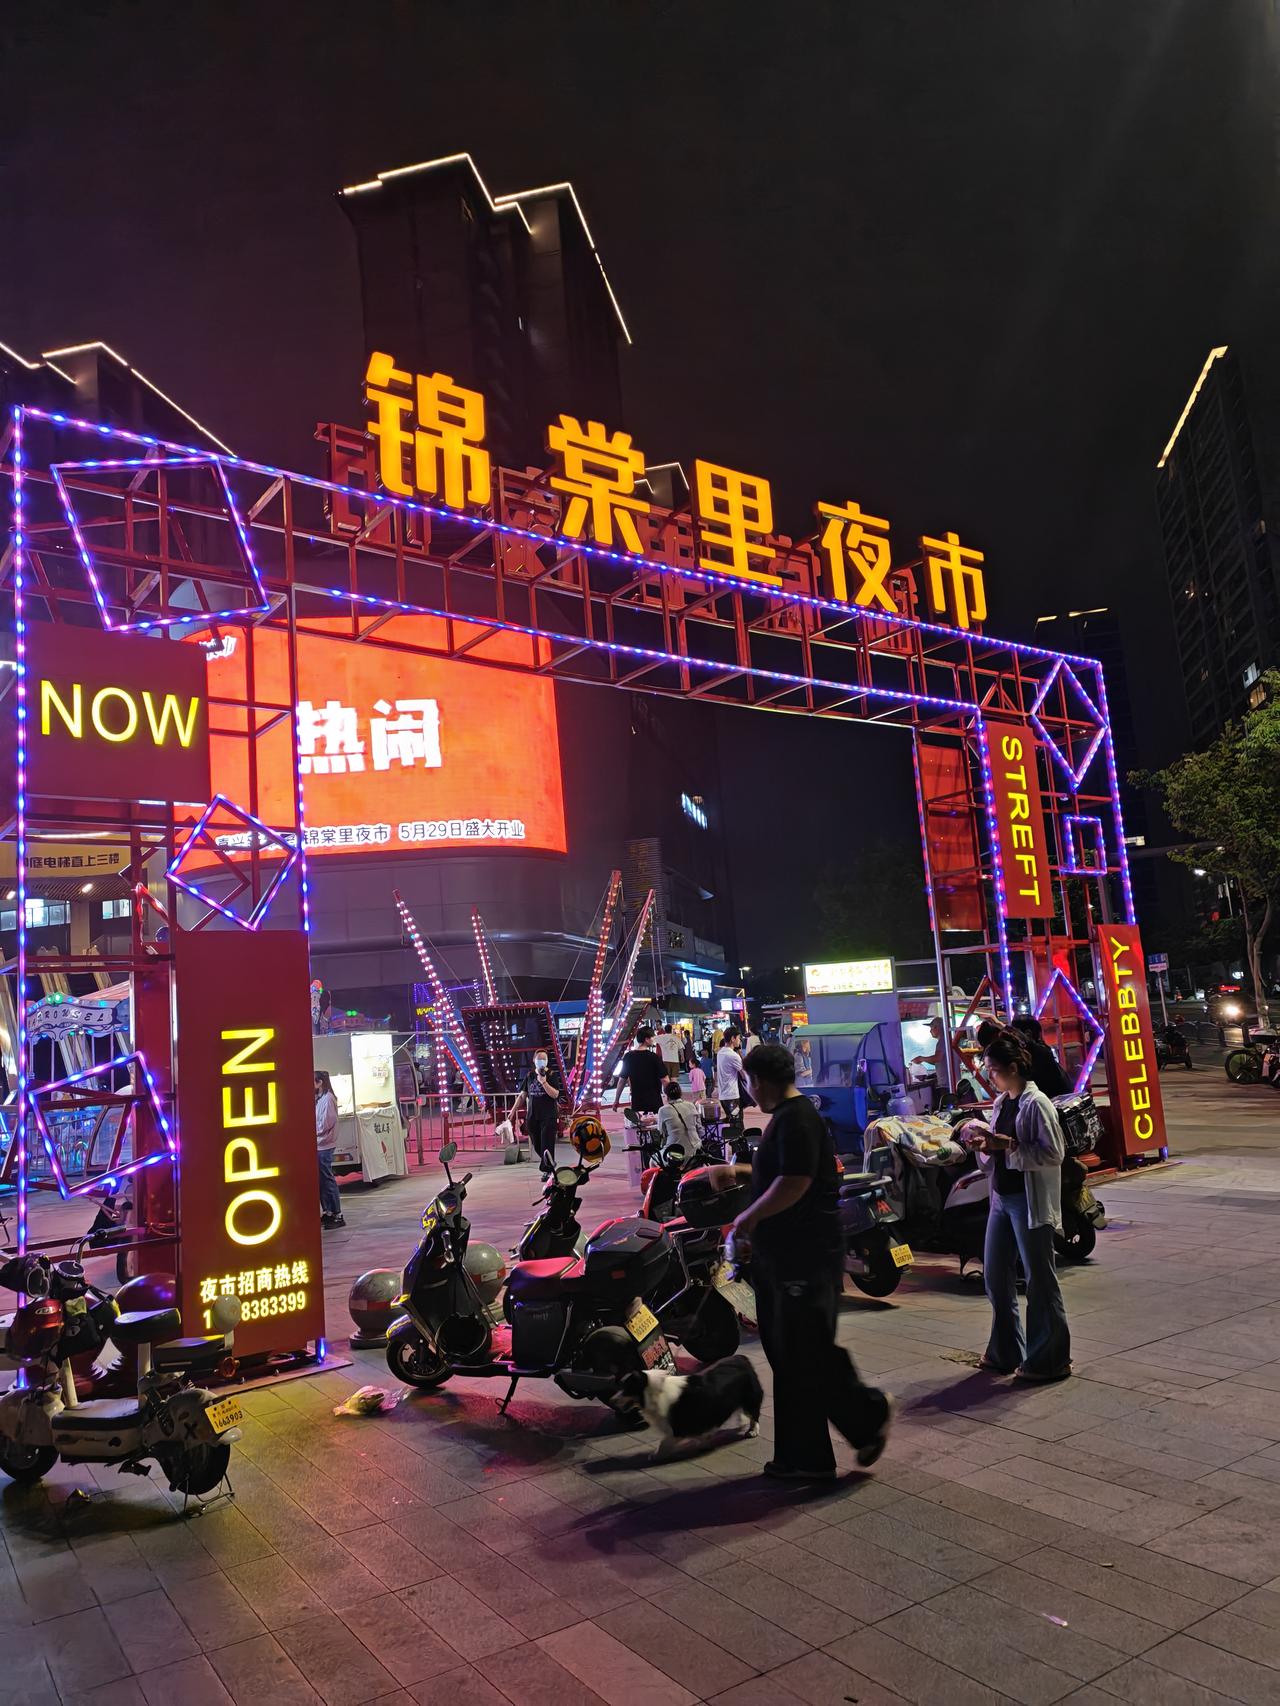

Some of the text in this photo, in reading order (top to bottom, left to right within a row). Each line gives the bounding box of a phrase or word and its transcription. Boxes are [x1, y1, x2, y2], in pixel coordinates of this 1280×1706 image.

[364, 351, 988, 633] 锦棠里夜市
[39, 680, 201, 749] NOW
[297, 697, 443, 775] 热闹
[1001, 735, 1042, 907] STREFT
[1110, 937, 1154, 1141] CELEBBTY
[221, 1028, 283, 1246] OPEN
[199, 1260, 310, 1304] 夜市招商热线
[202, 1290, 308, 1330] 18383399
[214, 1410, 244, 1429] 1663903
